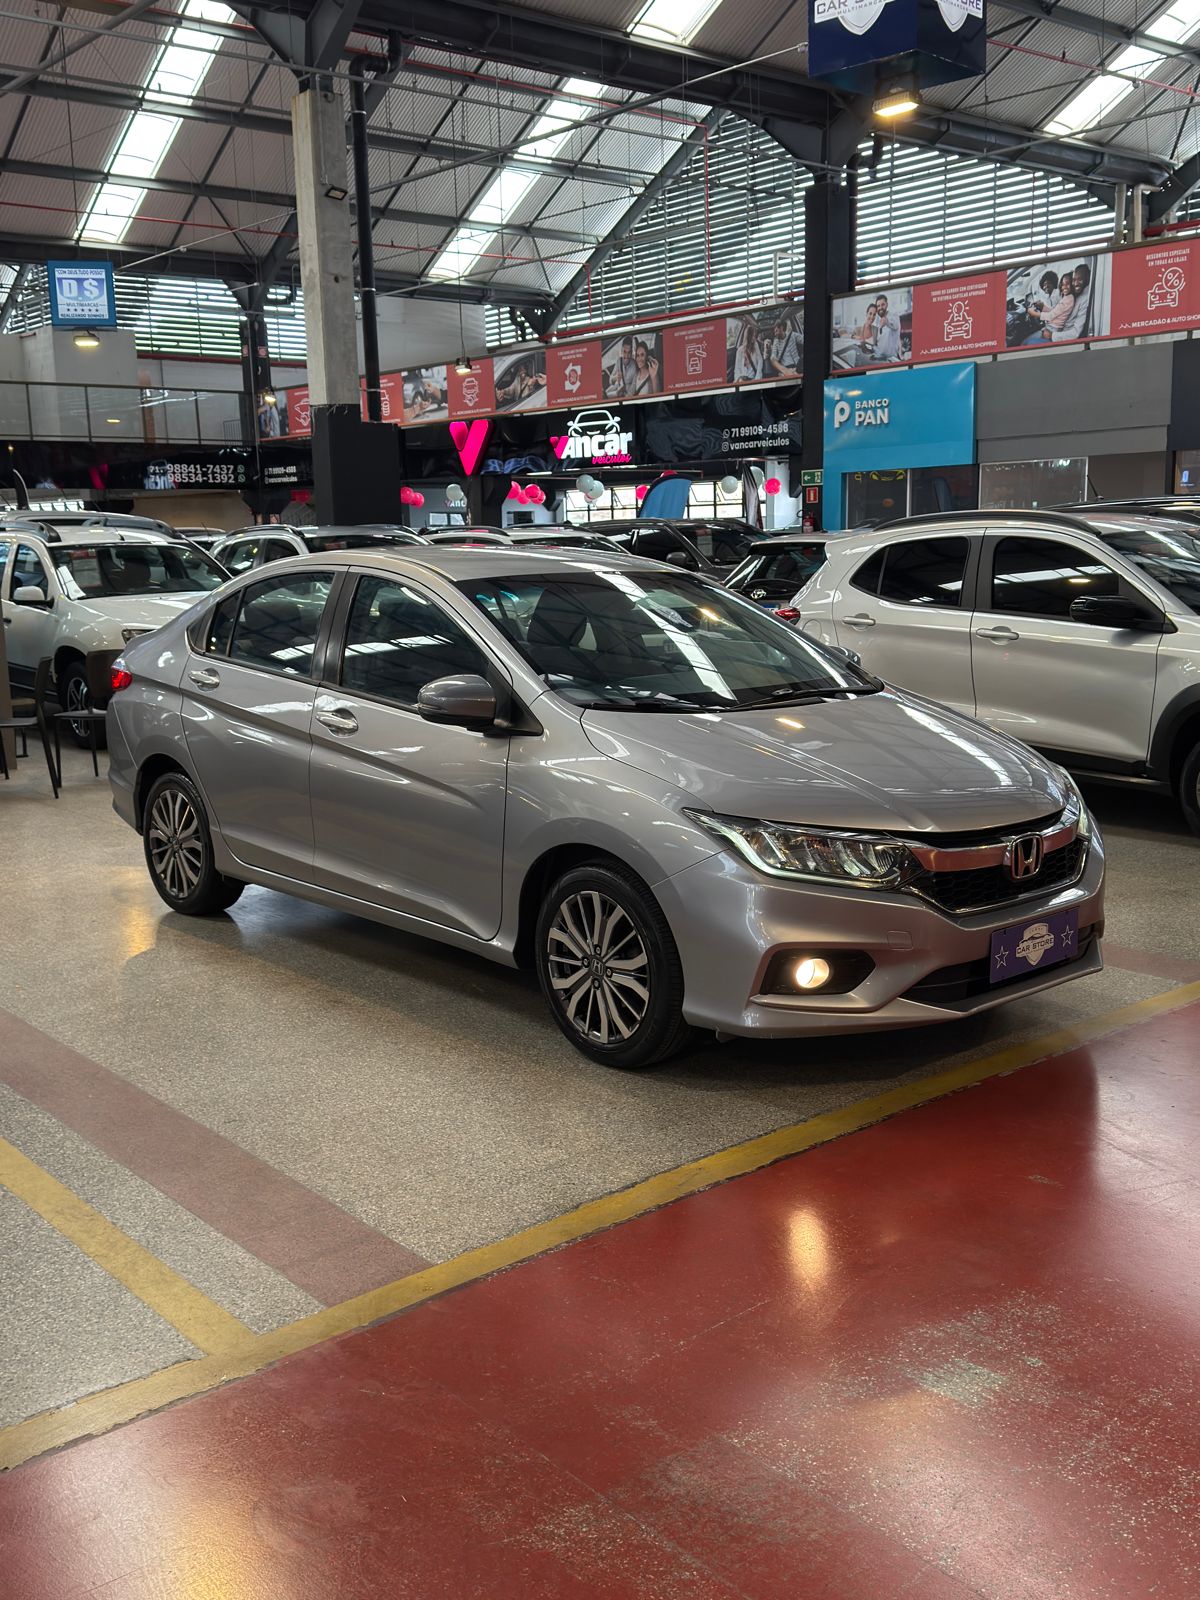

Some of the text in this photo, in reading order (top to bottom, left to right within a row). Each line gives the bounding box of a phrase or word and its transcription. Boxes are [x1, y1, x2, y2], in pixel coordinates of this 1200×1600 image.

[817, 0, 848, 14] CAR
[1132, 318, 1166, 328] MERCADÃO
[856, 399, 888, 409] BANCO
[856, 408, 888, 426] PAN
[731, 428, 739, 437] 71
[730, 437, 789, 450] vancarveiculos
[168, 464, 234, 473] 98841-7437
[168, 474, 235, 483] 98534-1392
[1017, 938, 1053, 954] CAR STORE
